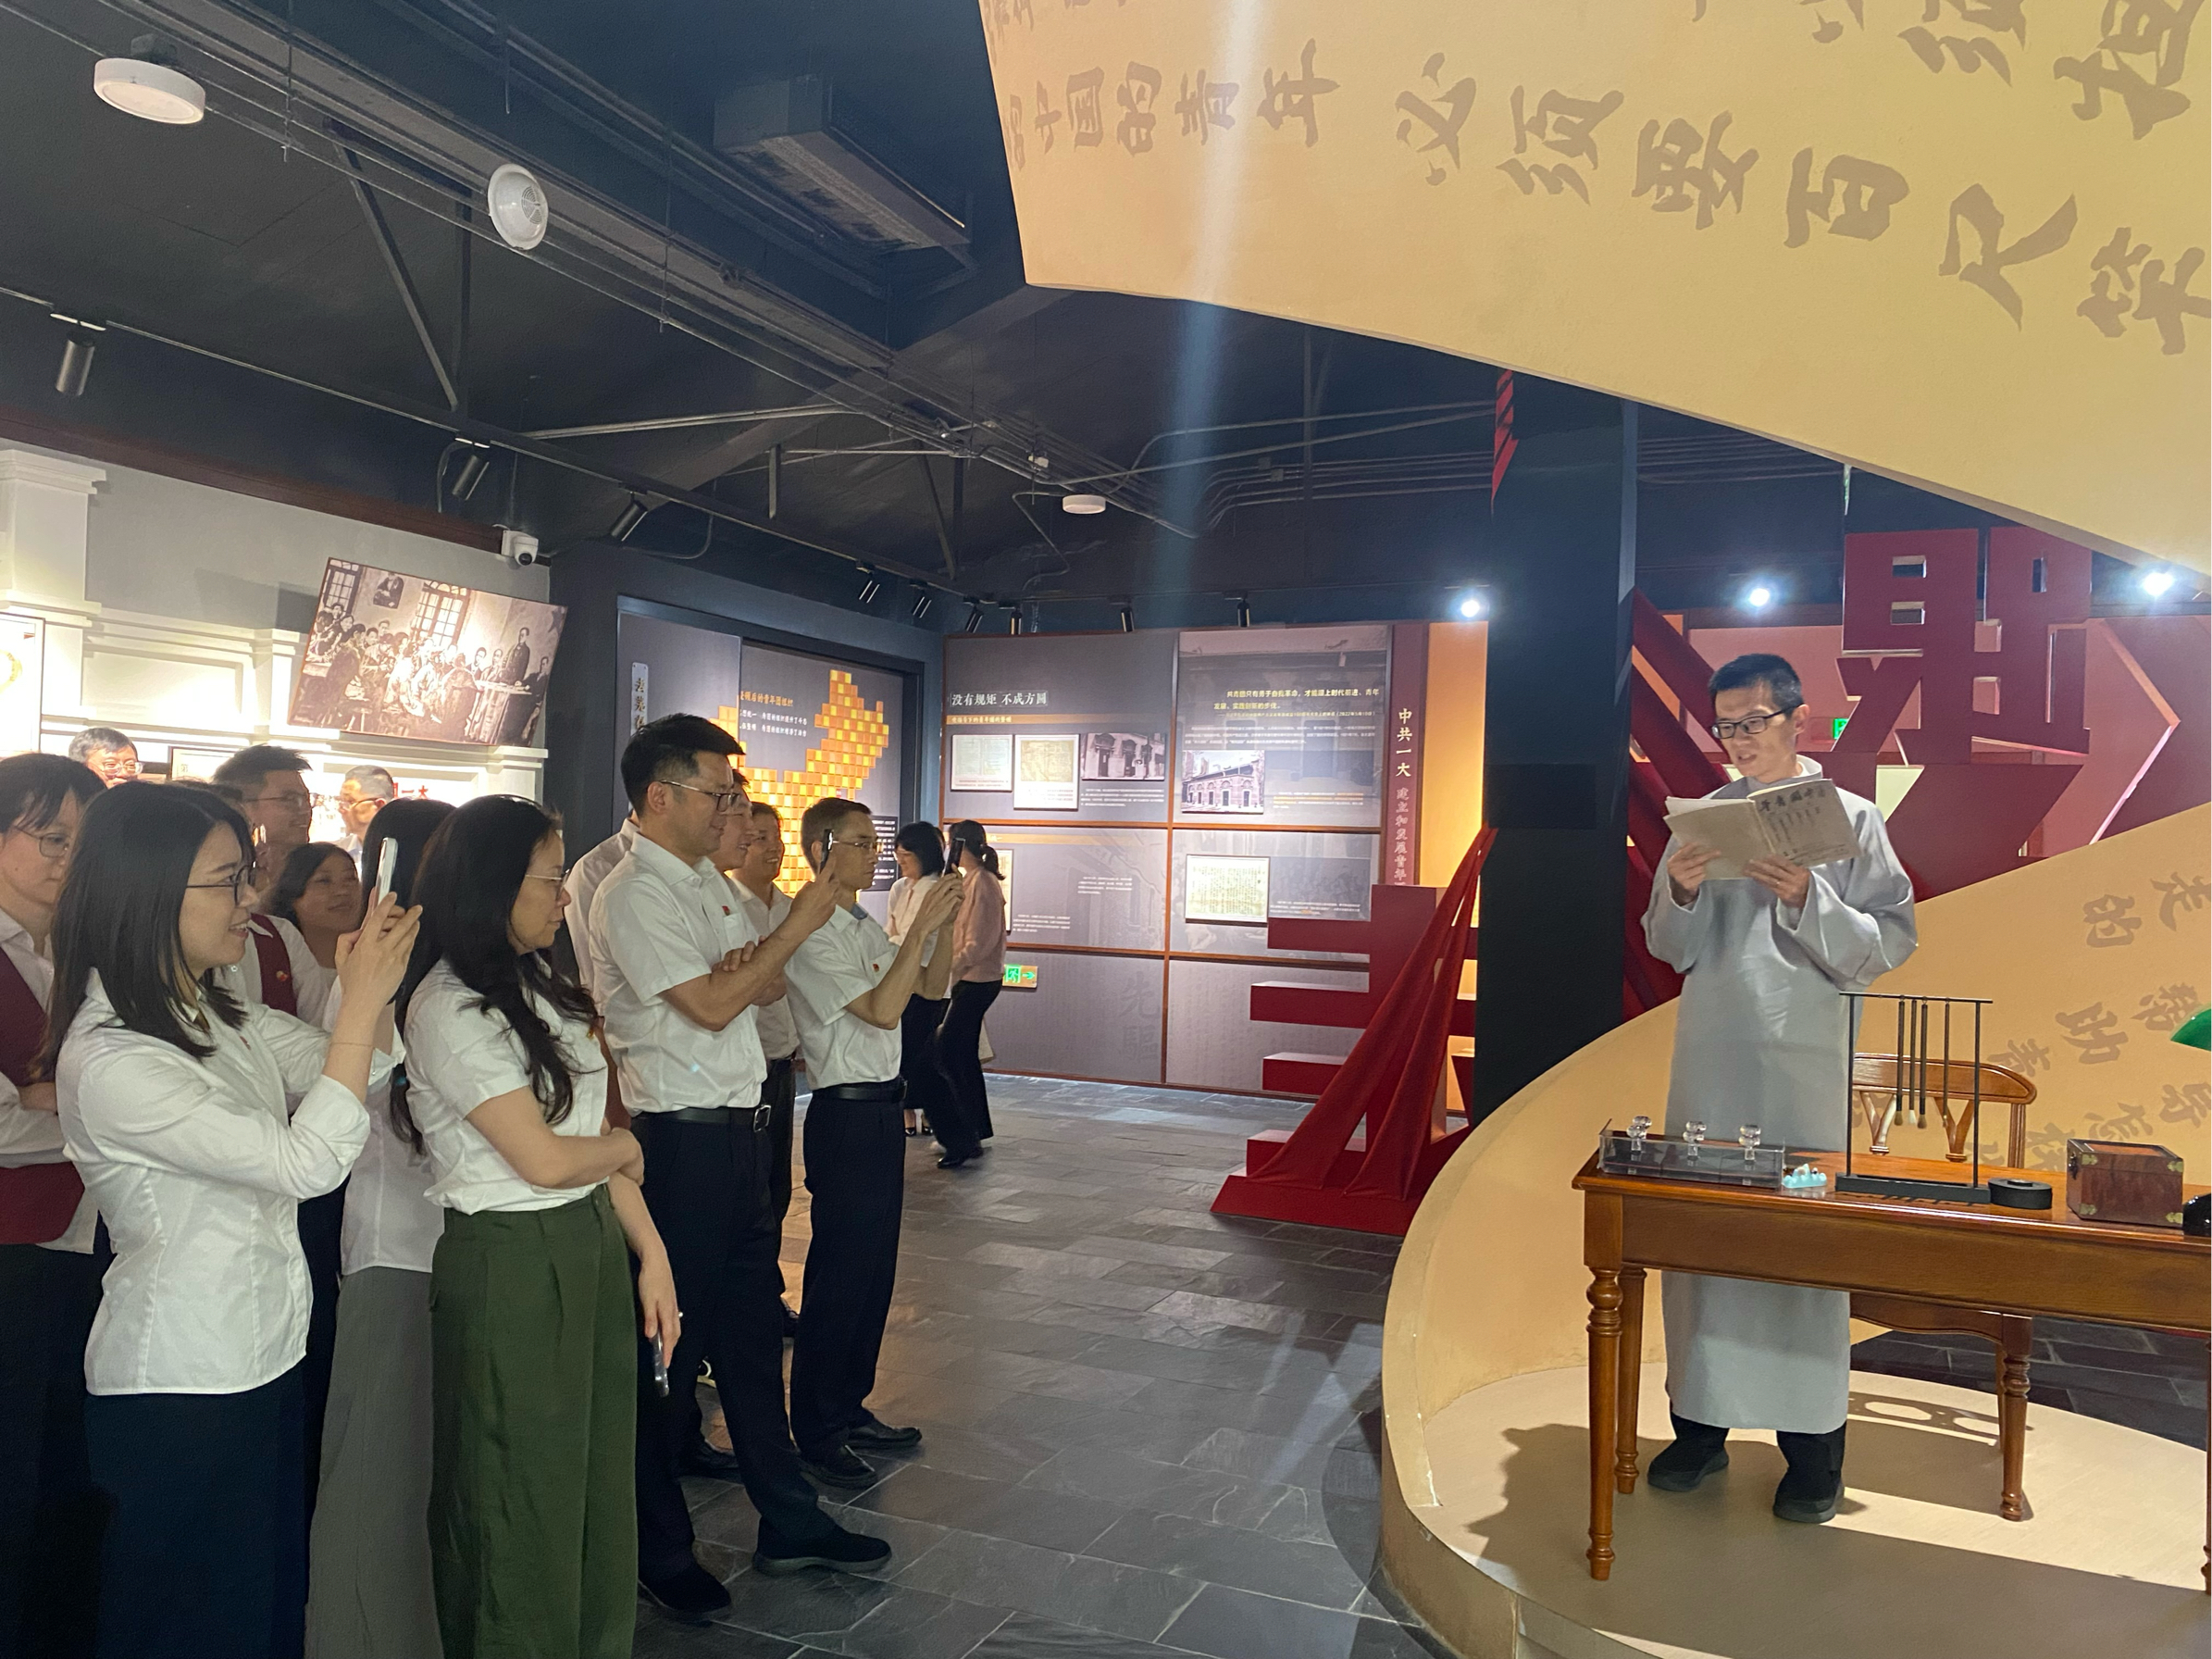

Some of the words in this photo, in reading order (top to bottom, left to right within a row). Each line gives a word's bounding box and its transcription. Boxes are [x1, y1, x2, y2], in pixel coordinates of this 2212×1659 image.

[1396, 707, 1412, 778] 中共一大
[1394, 787, 1410, 885] 建立和发展青年
